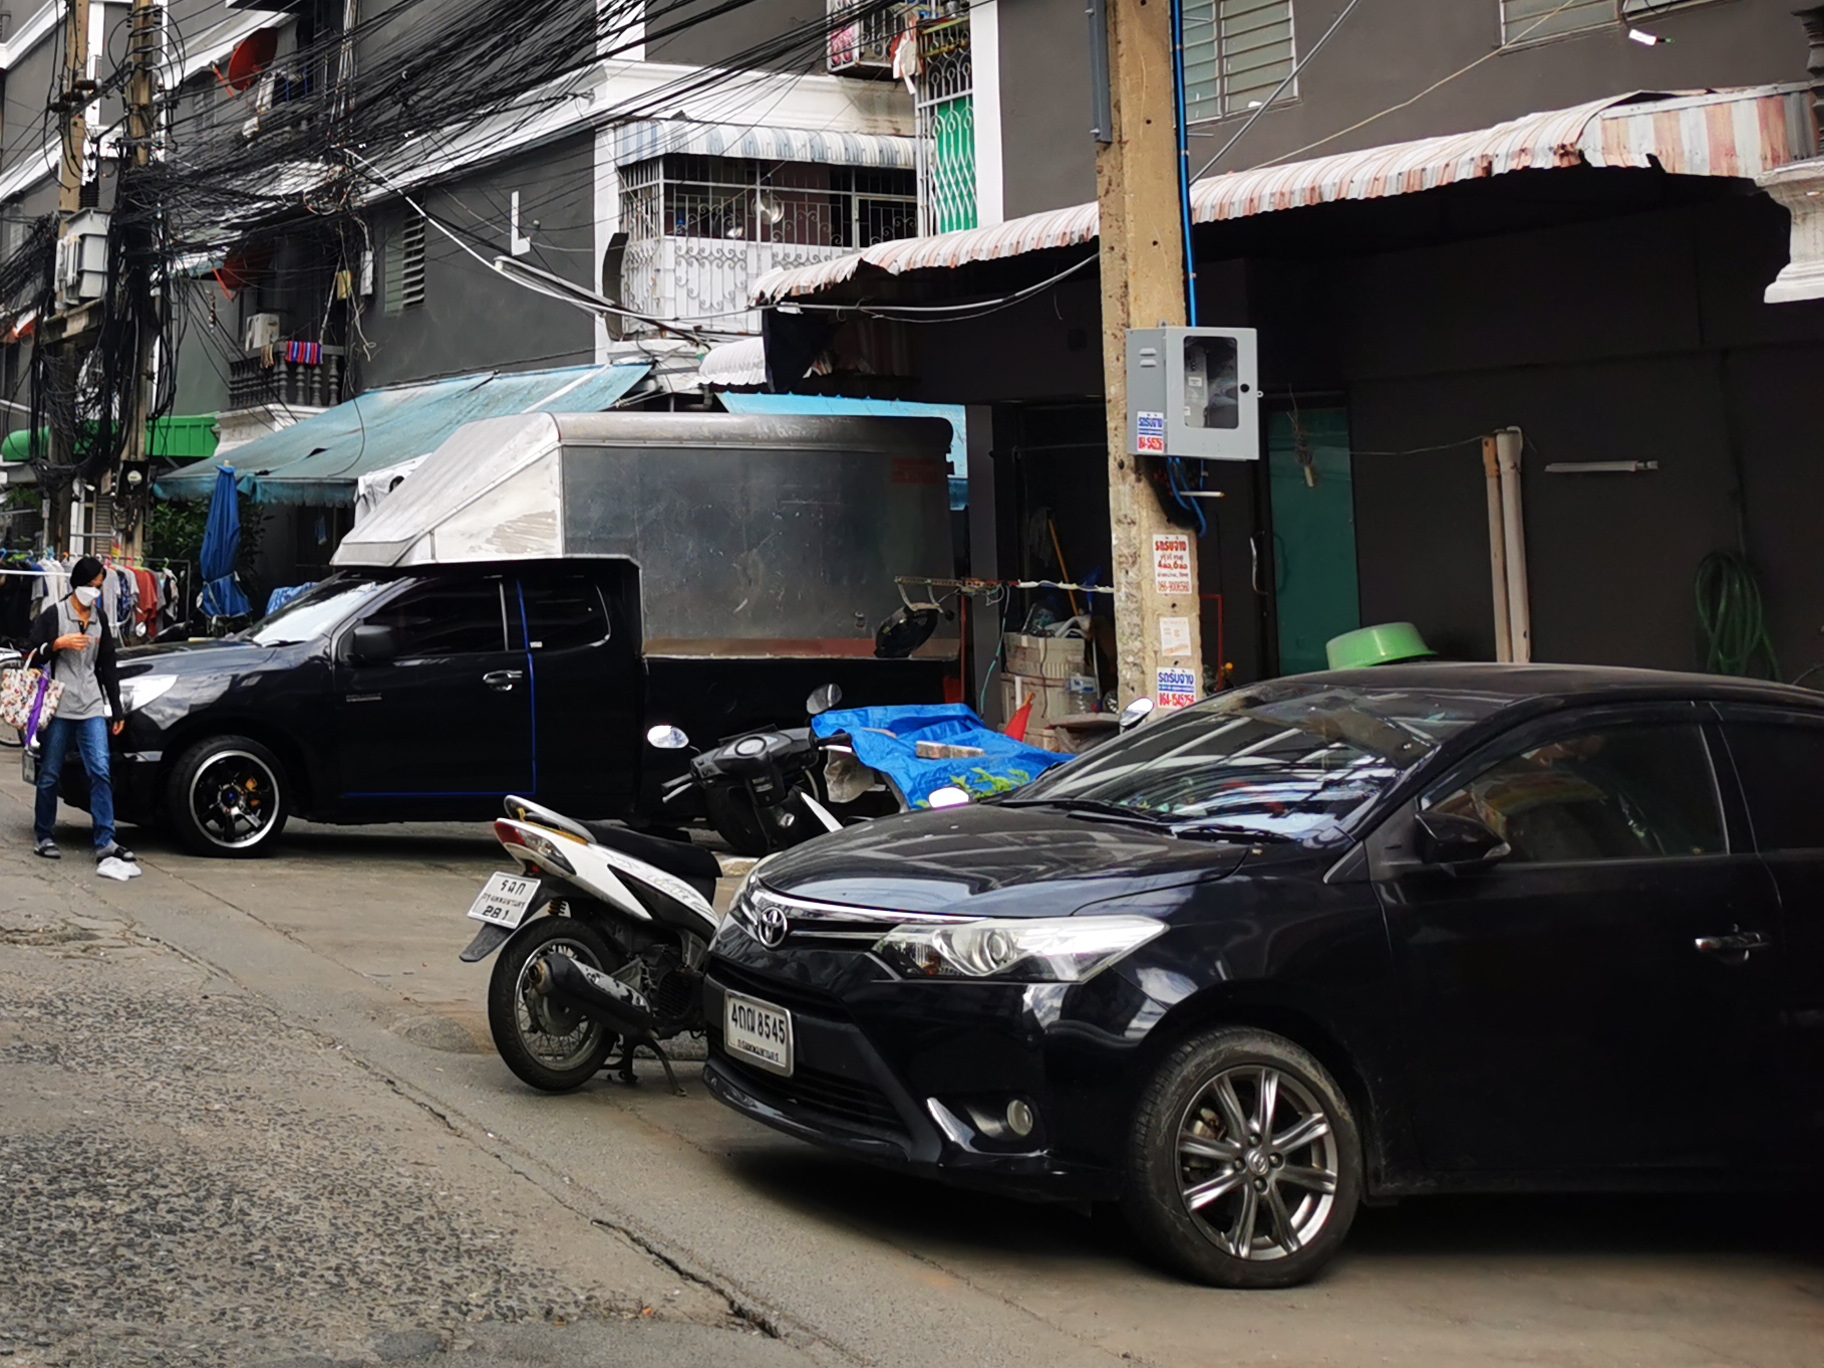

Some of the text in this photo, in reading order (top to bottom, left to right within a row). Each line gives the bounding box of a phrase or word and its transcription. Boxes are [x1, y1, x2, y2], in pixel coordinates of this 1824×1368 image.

[1158, 669, 1194, 685] รถรับจ้าง
[481, 904, 511, 921] 281
[757, 1011, 786, 1046] 8545
